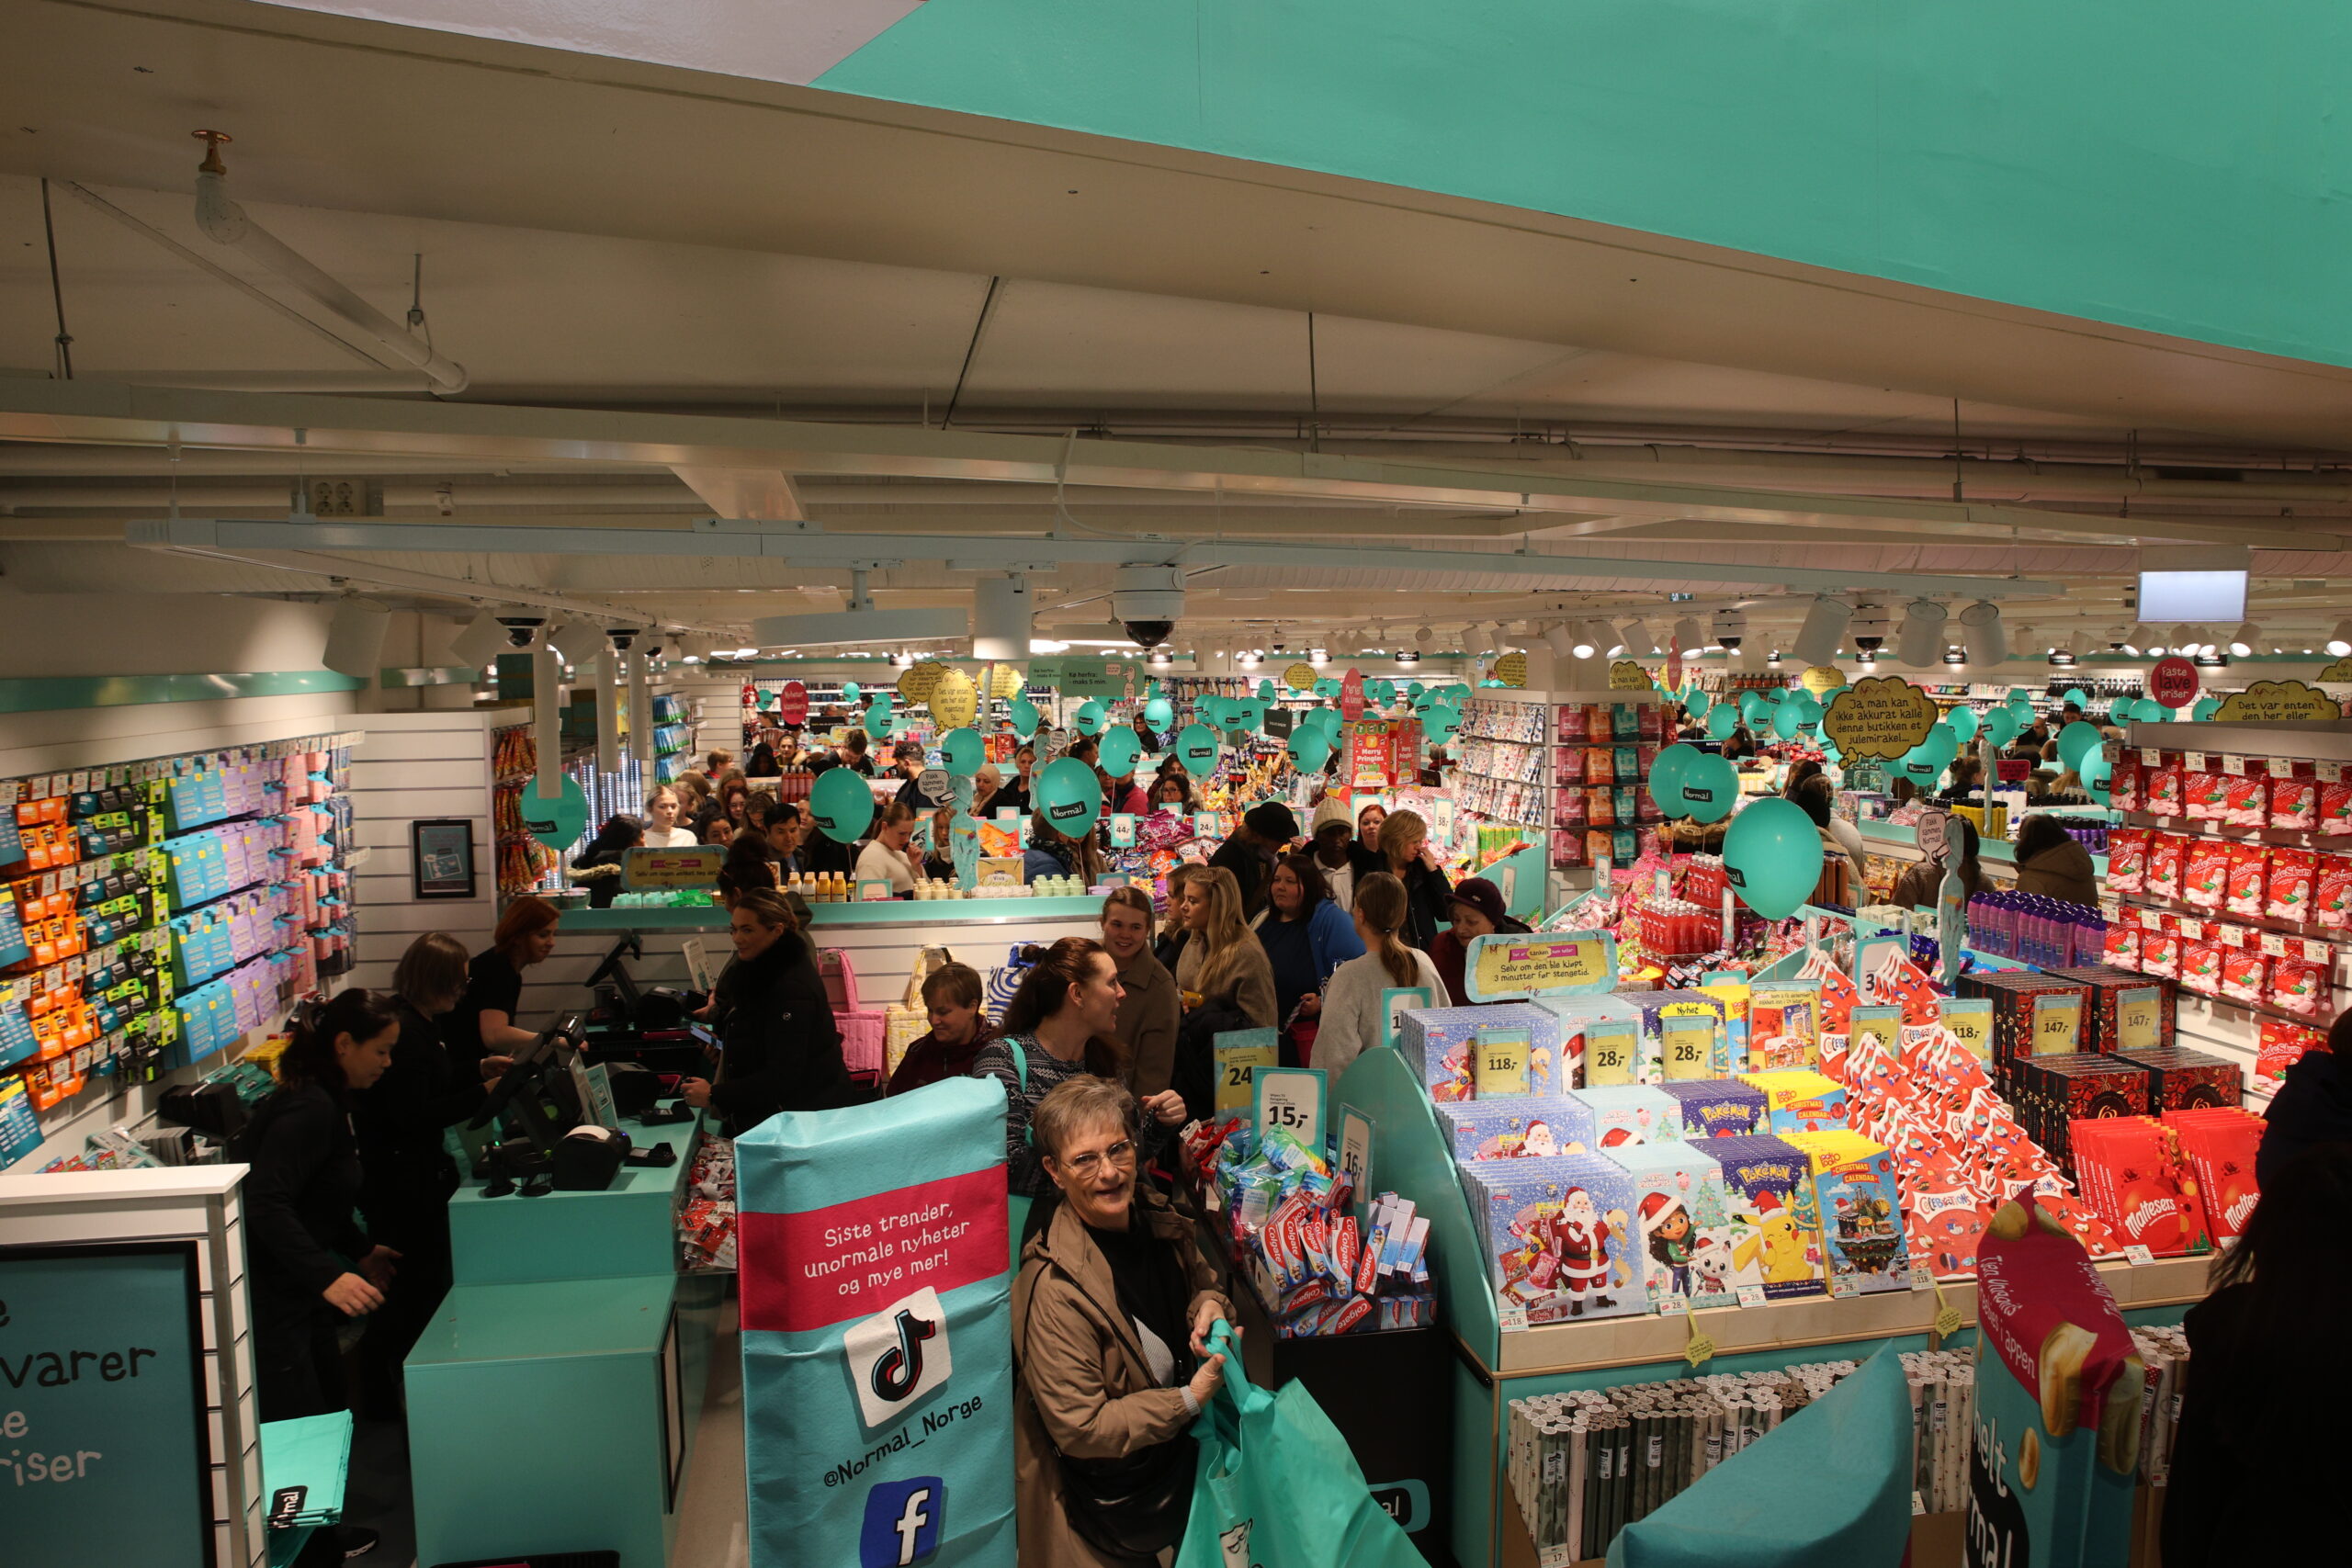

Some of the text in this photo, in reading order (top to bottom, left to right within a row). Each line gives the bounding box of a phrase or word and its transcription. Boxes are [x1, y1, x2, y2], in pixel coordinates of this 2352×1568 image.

[2161, 673, 2191, 689] lave
[2161, 689, 2189, 699] priser
[1849, 700, 1864, 709] Ja,
[1891, 698, 1909, 707] kan
[2238, 701, 2256, 709] Det
[1836, 709, 1922, 720] ikke akkurat kalle
[2242, 712, 2312, 720] den her eller
[1838, 724, 1864, 733] denne
[1867, 722, 1907, 732] butikken
[1684, 788, 1711, 800] Normal
[1053, 805, 1083, 818] Normal
[2270, 867, 2312, 886] JuleSkum
[1501, 964, 1518, 973] Selv
[1534, 962, 1547, 970] den
[1549, 961, 1561, 969] ble
[1563, 960, 1583, 970] kjøpt
[1501, 973, 1536, 981] minutter
[1538, 970, 1550, 979] før
[1553, 968, 1589, 978] stengetid.
[1678, 1005, 1698, 1014] Nyhet
[2044, 1021, 2069, 1034] 147,-
[2128, 1015, 2150, 1027] 147,-
[1598, 1051, 1624, 1067] 28,-
[1675, 1045, 1702, 1062] 28,-
[2258, 1043, 2302, 1060] JuleSkum
[1488, 1058, 1518, 1071] 118,-
[1790, 1100, 1823, 1110] CHRISTMAS
[1268, 1106, 1308, 1128] 15,-
[1799, 1111, 1828, 1119] CALENDAR
[1836, 1163, 1869, 1174] CHRISTMAS
[1845, 1174, 1874, 1183] CALENDAR
[2124, 1198, 2176, 1240] Maltesers
[2223, 1192, 2261, 1233] Maltes
[824, 1202, 954, 1247] Siste trender,
[1268, 1225, 1283, 1264] Colgate
[1286, 1220, 1299, 1256] Colgate
[1306, 1224, 1319, 1251] Colgate
[804, 1222, 970, 1279] unormale nyheter
[1341, 1231, 1351, 1269] Colgate
[838, 1249, 949, 1295] og mye mer!
[1358, 1253, 1374, 1290] Colgate
[1981, 1255, 2004, 1279] Tjen
[1292, 1288, 1321, 1308] Colgate
[1338, 1302, 1369, 1330] Colgate
[2005, 1330, 2036, 1380] appen
[0, 1347, 156, 1388] varer
[823, 1396, 983, 1487] @Normal_Norge
